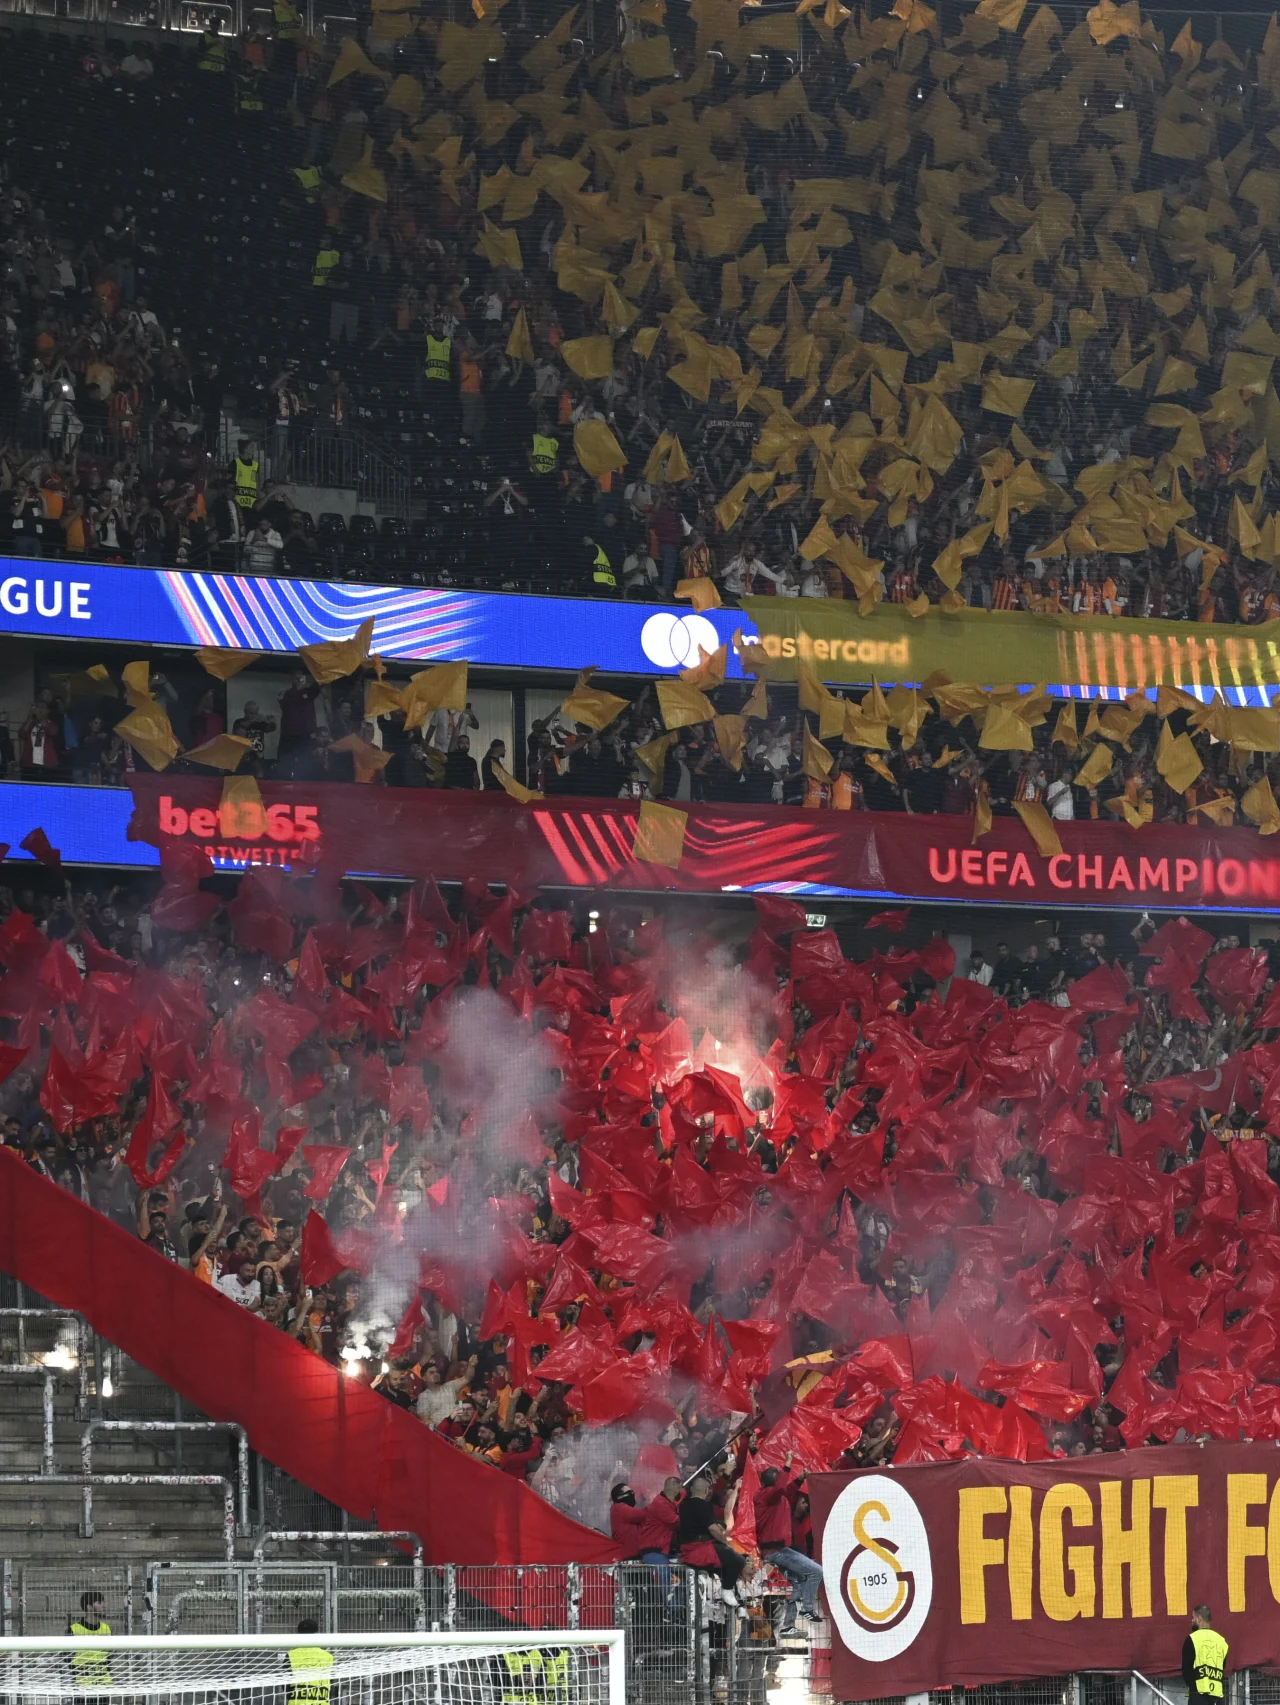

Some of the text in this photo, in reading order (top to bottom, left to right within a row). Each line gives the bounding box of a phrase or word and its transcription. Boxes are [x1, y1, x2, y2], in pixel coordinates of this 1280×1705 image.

[0, 577, 92, 619] GUE
[158, 796, 322, 843] bet365
[928, 847, 1036, 888] UEFA
[958, 1473, 1200, 1625] FIGHT
[862, 1572, 888, 1587] 1905
